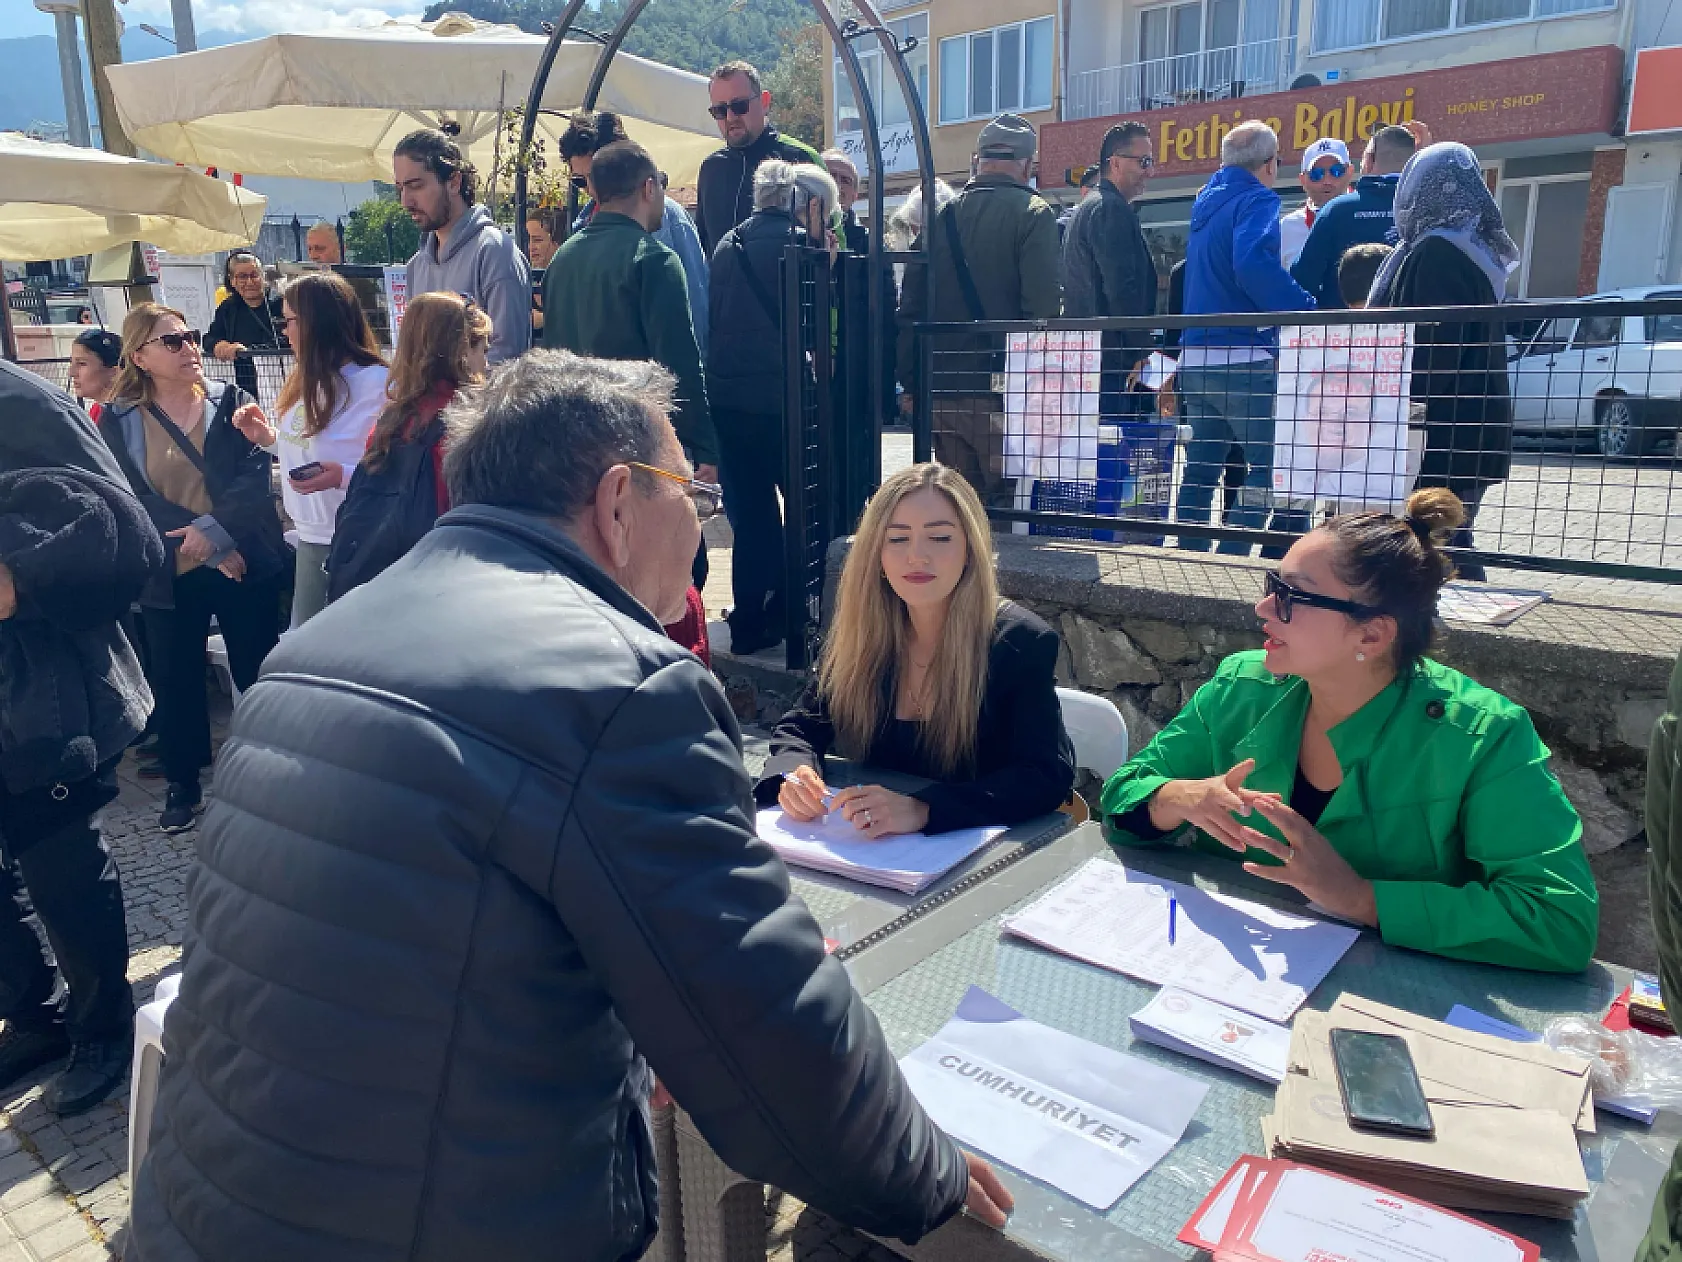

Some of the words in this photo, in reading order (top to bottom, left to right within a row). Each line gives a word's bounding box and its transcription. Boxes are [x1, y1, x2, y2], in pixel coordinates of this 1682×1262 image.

[1158, 109, 1282, 163] Feth
[1293, 87, 1414, 150] Balevi
[1447, 98, 1499, 115] HONEY
[1502, 93, 1545, 109] SHOP
[938, 1055, 1141, 1149] CUMHURİYET
